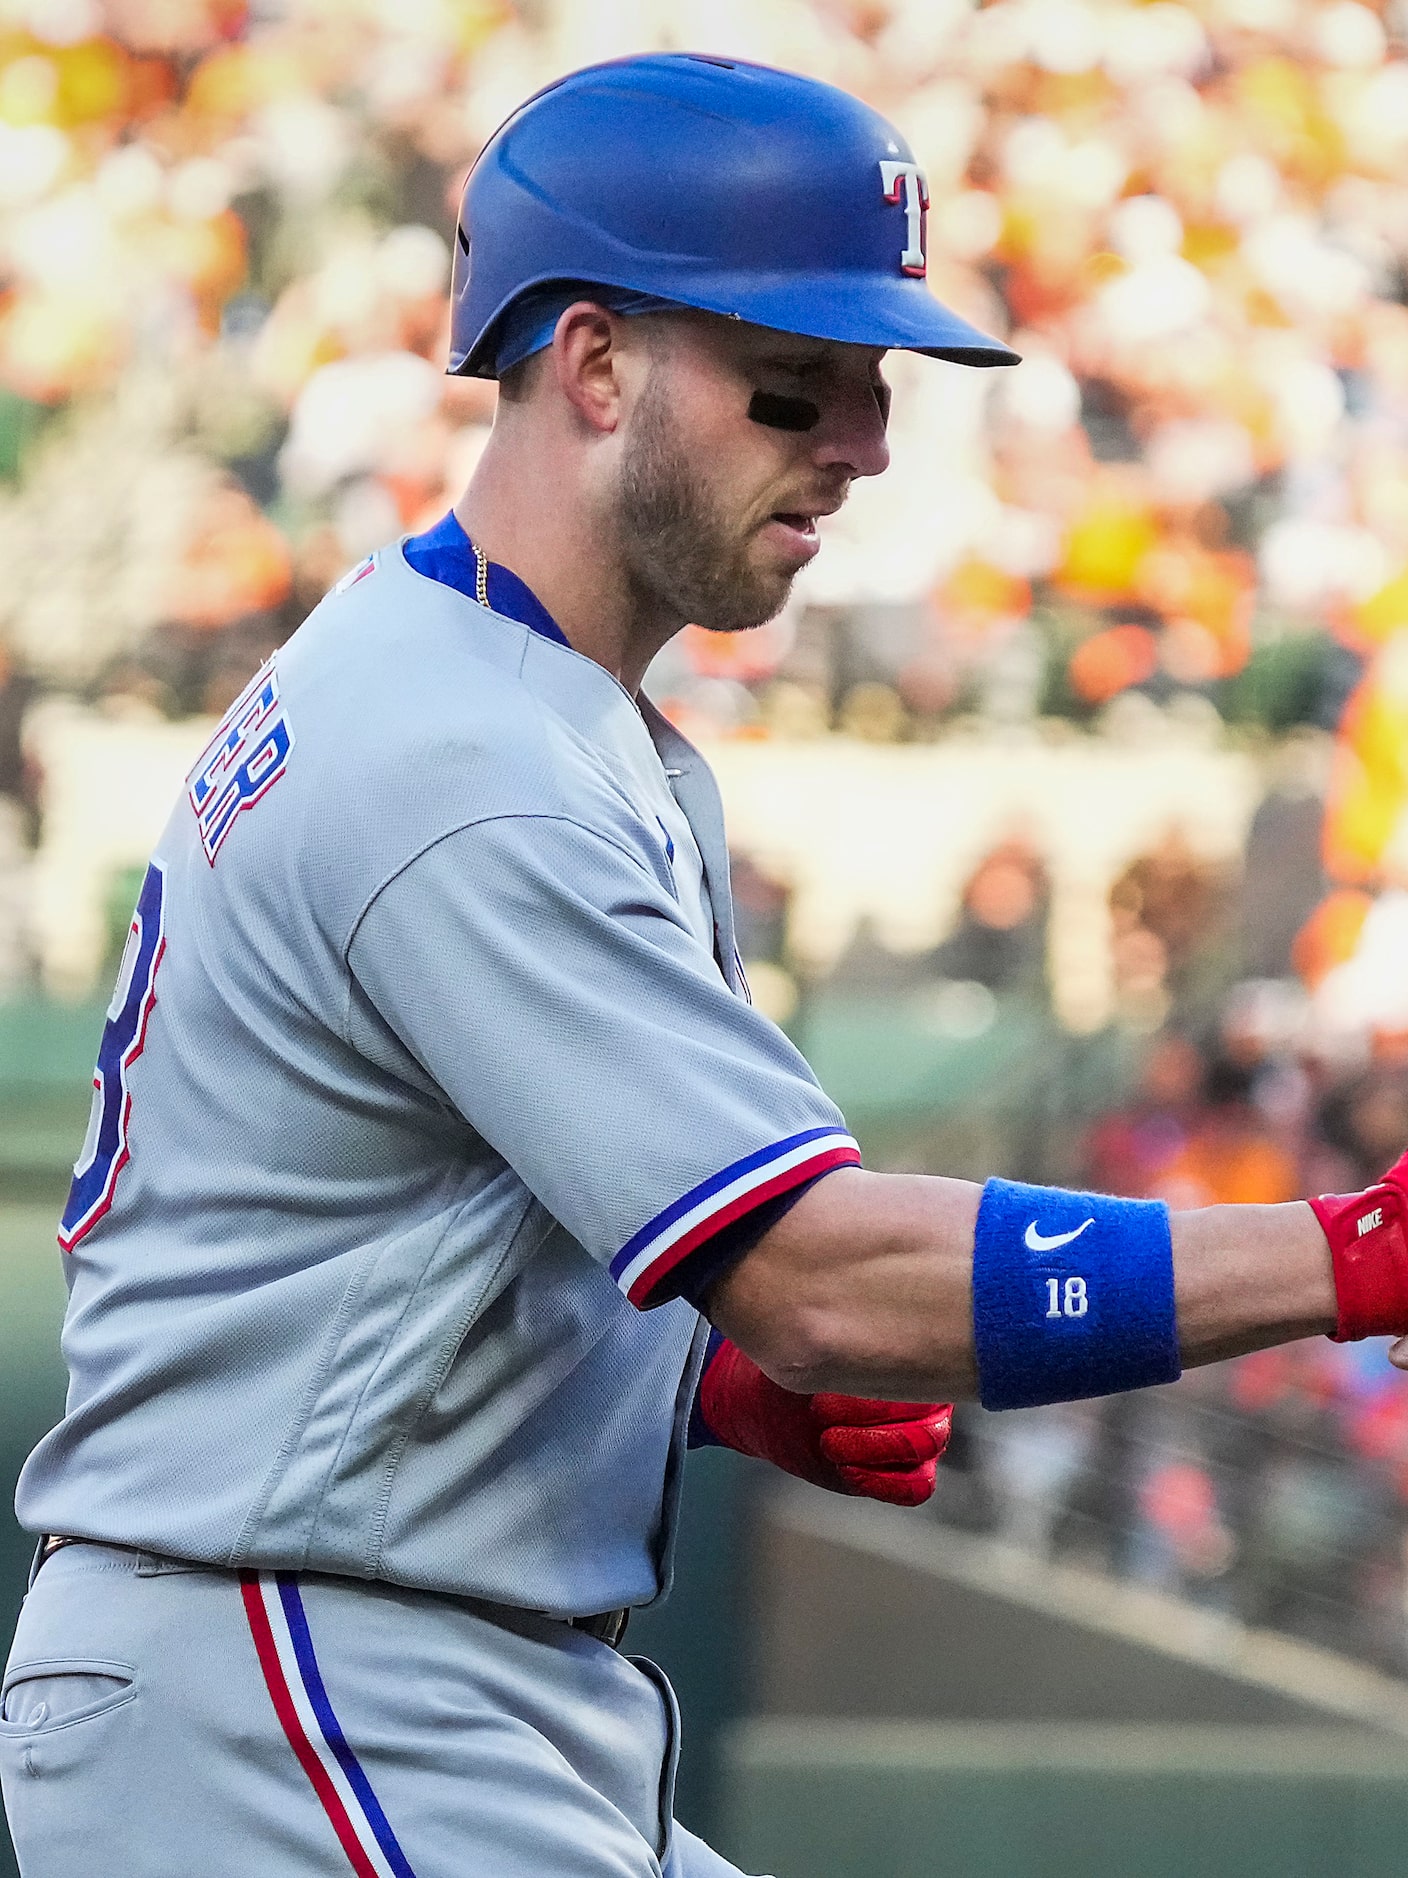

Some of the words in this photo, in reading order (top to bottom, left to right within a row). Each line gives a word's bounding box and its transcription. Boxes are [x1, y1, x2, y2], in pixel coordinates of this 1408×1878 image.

[879, 160, 930, 279] T
[1356, 1207, 1384, 1238] NIKE
[1045, 1276, 1089, 1319] 18
